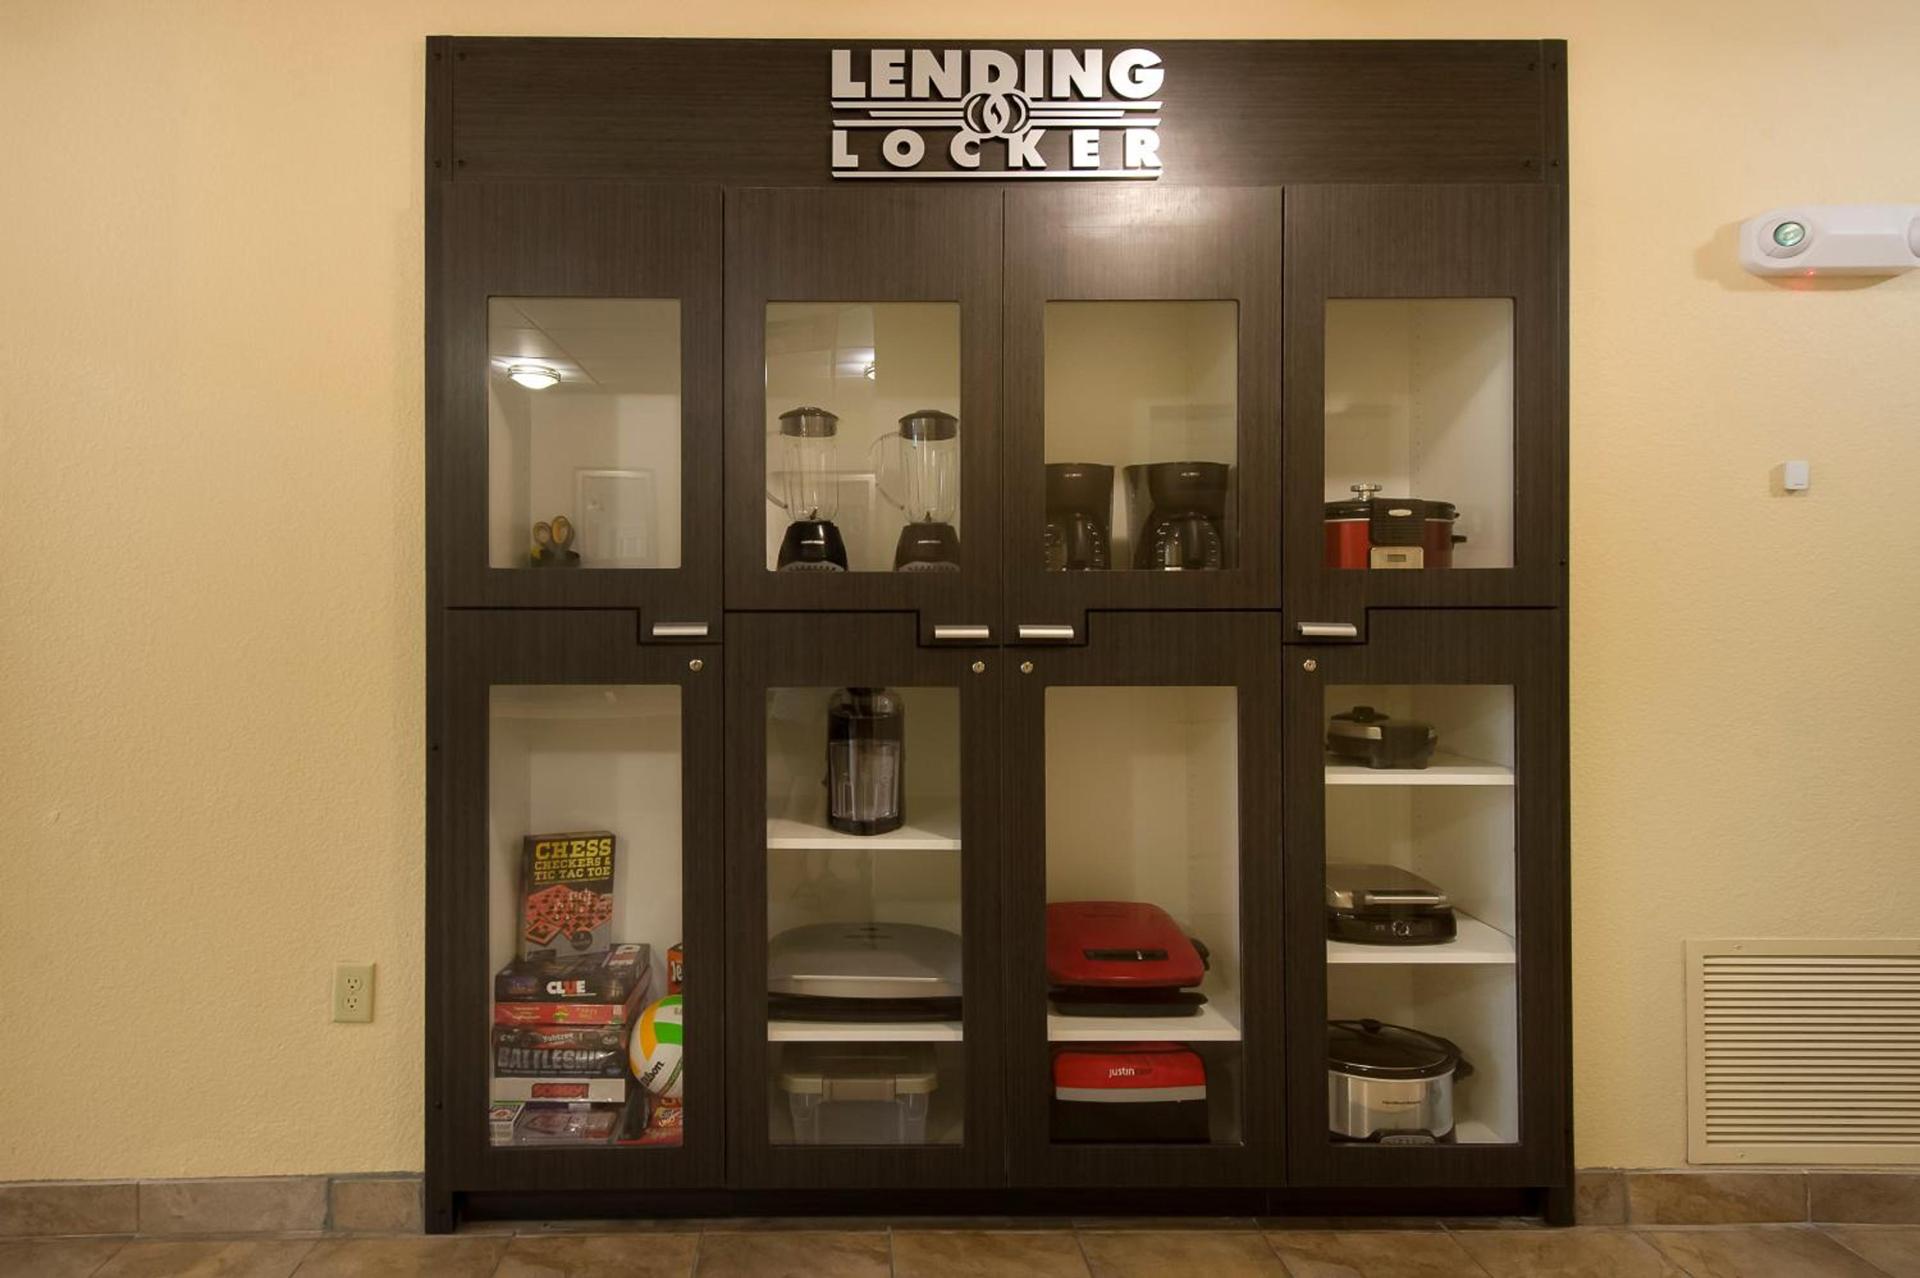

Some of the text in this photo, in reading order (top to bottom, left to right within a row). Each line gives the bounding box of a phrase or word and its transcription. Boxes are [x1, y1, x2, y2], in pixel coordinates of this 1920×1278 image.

[832, 49, 1164, 99] LENDING
[832, 129, 1162, 168] LOCKER
[535, 838, 612, 860] CHESS
[535, 857, 601, 871] CHECKERS
[534, 866, 611, 881] TIC TAC TOE
[546, 980, 586, 995] CLUE
[497, 1047, 604, 1069] BATTLESHIP
[1109, 1067, 1135, 1079] justin
